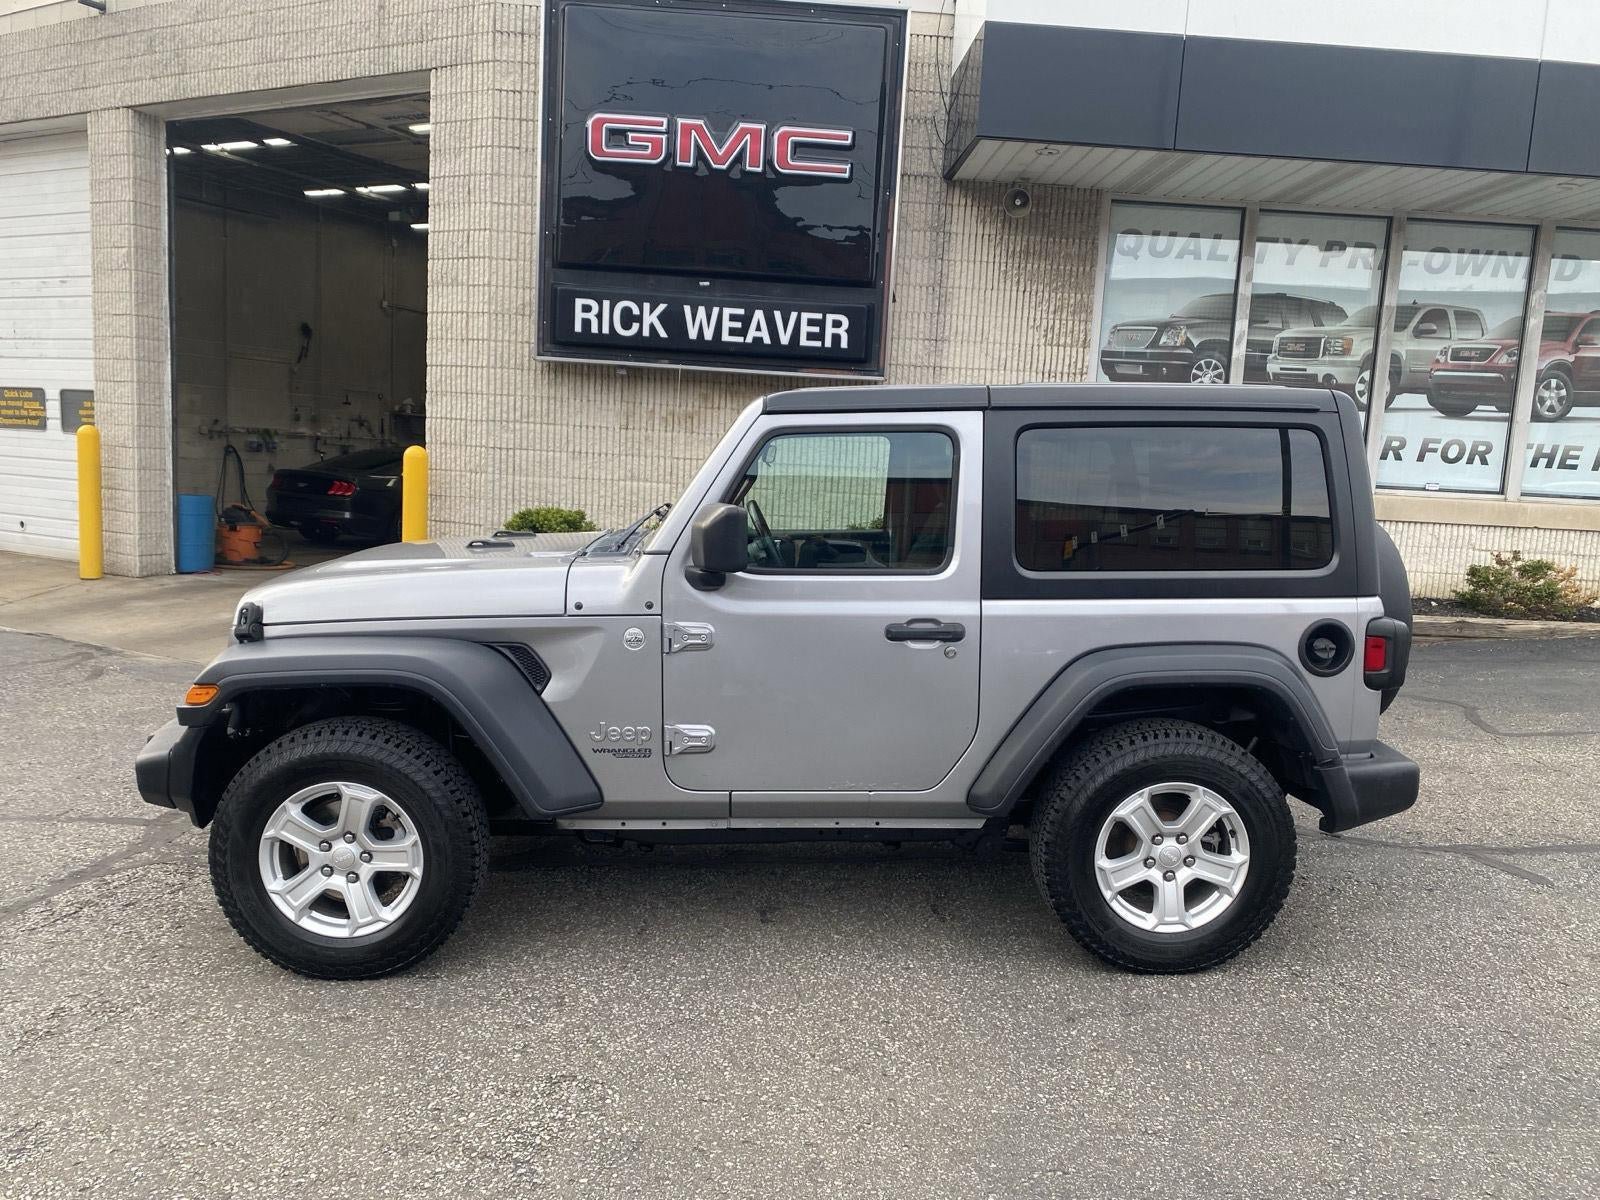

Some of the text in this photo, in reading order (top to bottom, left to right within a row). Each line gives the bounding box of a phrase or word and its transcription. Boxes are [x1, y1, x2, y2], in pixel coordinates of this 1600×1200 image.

[585, 112, 854, 179] GMC
[1117, 228, 1584, 282] QUALTY PR-OWND
[573, 297, 850, 350] RICK WEAVER
[1416, 437, 1494, 466] FOR
[590, 721, 652, 745] Jeep
